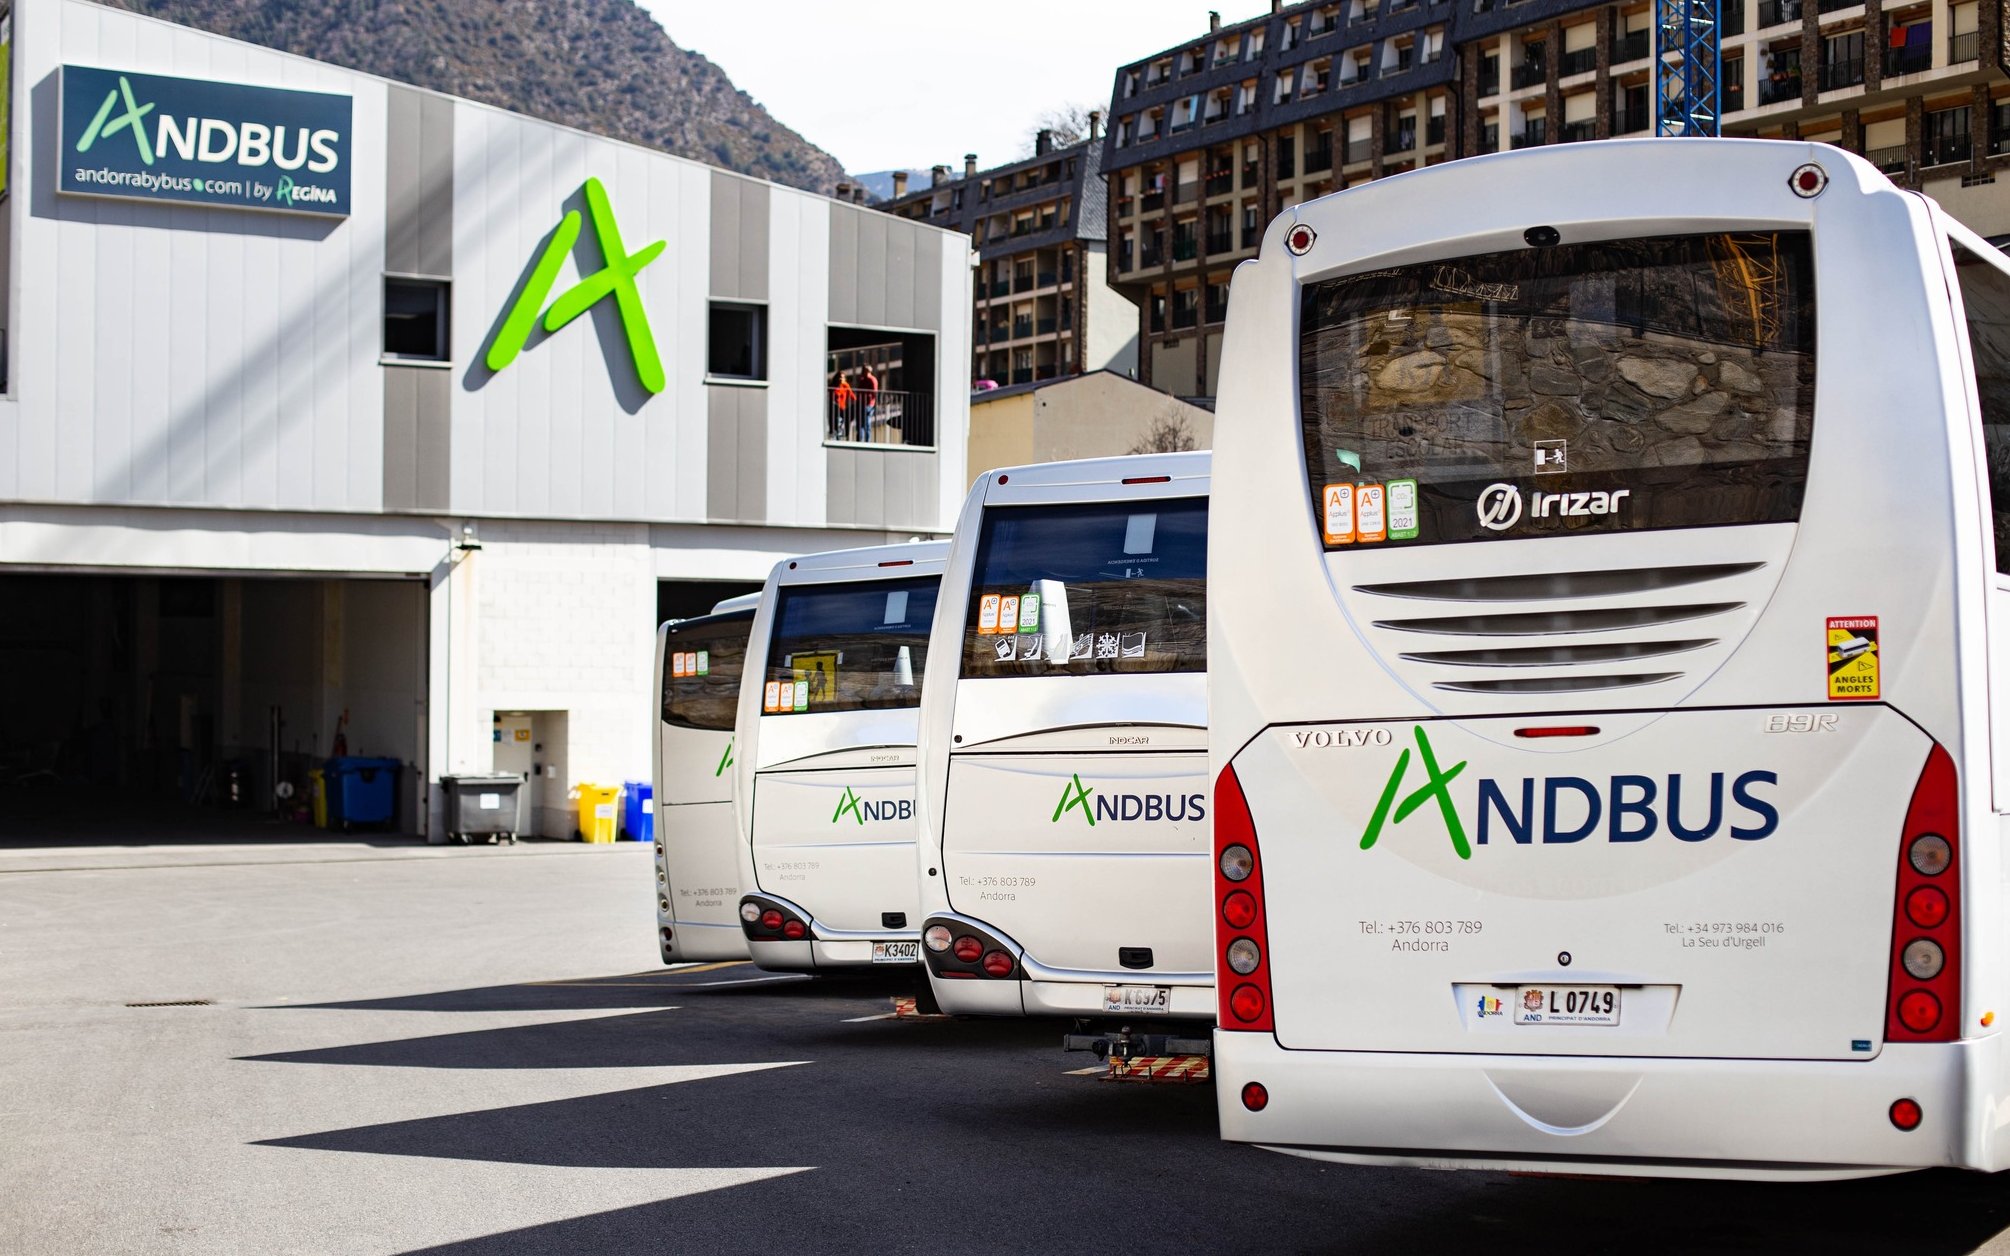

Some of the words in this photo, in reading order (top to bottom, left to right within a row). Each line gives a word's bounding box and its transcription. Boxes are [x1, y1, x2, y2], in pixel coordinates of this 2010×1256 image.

[75, 76, 340, 173] ANDBUS
[253, 181, 273, 201] by
[1531, 489, 1630, 518] Irizar
[1393, 517, 1413, 528] 2021
[1829, 620, 1876, 629] ATTENTION
[1835, 675, 1874, 684] ANGLES
[1837, 685, 1872, 693] MORTS
[1764, 713, 1839, 733] B9R
[1289, 729, 1392, 748] VOLVO
[1052, 773, 1205, 826] ANDBUS
[1359, 725, 1779, 860] ANDBUS
[832, 786, 916, 825] ANDB
[977, 877, 997, 886] +376
[1000, 877, 1017, 886] 803
[1020, 877, 1036, 887] 789
[980, 891, 1016, 900] Andorra
[1359, 921, 1383, 934] Tel.:
[1388, 921, 1421, 934] +376
[1425, 920, 1453, 934] 803
[1457, 921, 1483, 934] 789
[1688, 923, 1708, 934] +34
[1712, 923, 1732, 934] 973
[1736, 923, 1758, 934] 984
[1761, 923, 1784, 934] 016
[1392, 939, 1449, 951] Andorra
[1682, 937, 1695, 947] La
[1698, 937, 1719, 947] Seu
[1723, 936, 1766, 950] d'Urgell
[885, 944, 917, 957] K3402
[1567, 991, 1614, 1014] 0749
[1523, 1014, 1542, 1022] AND
